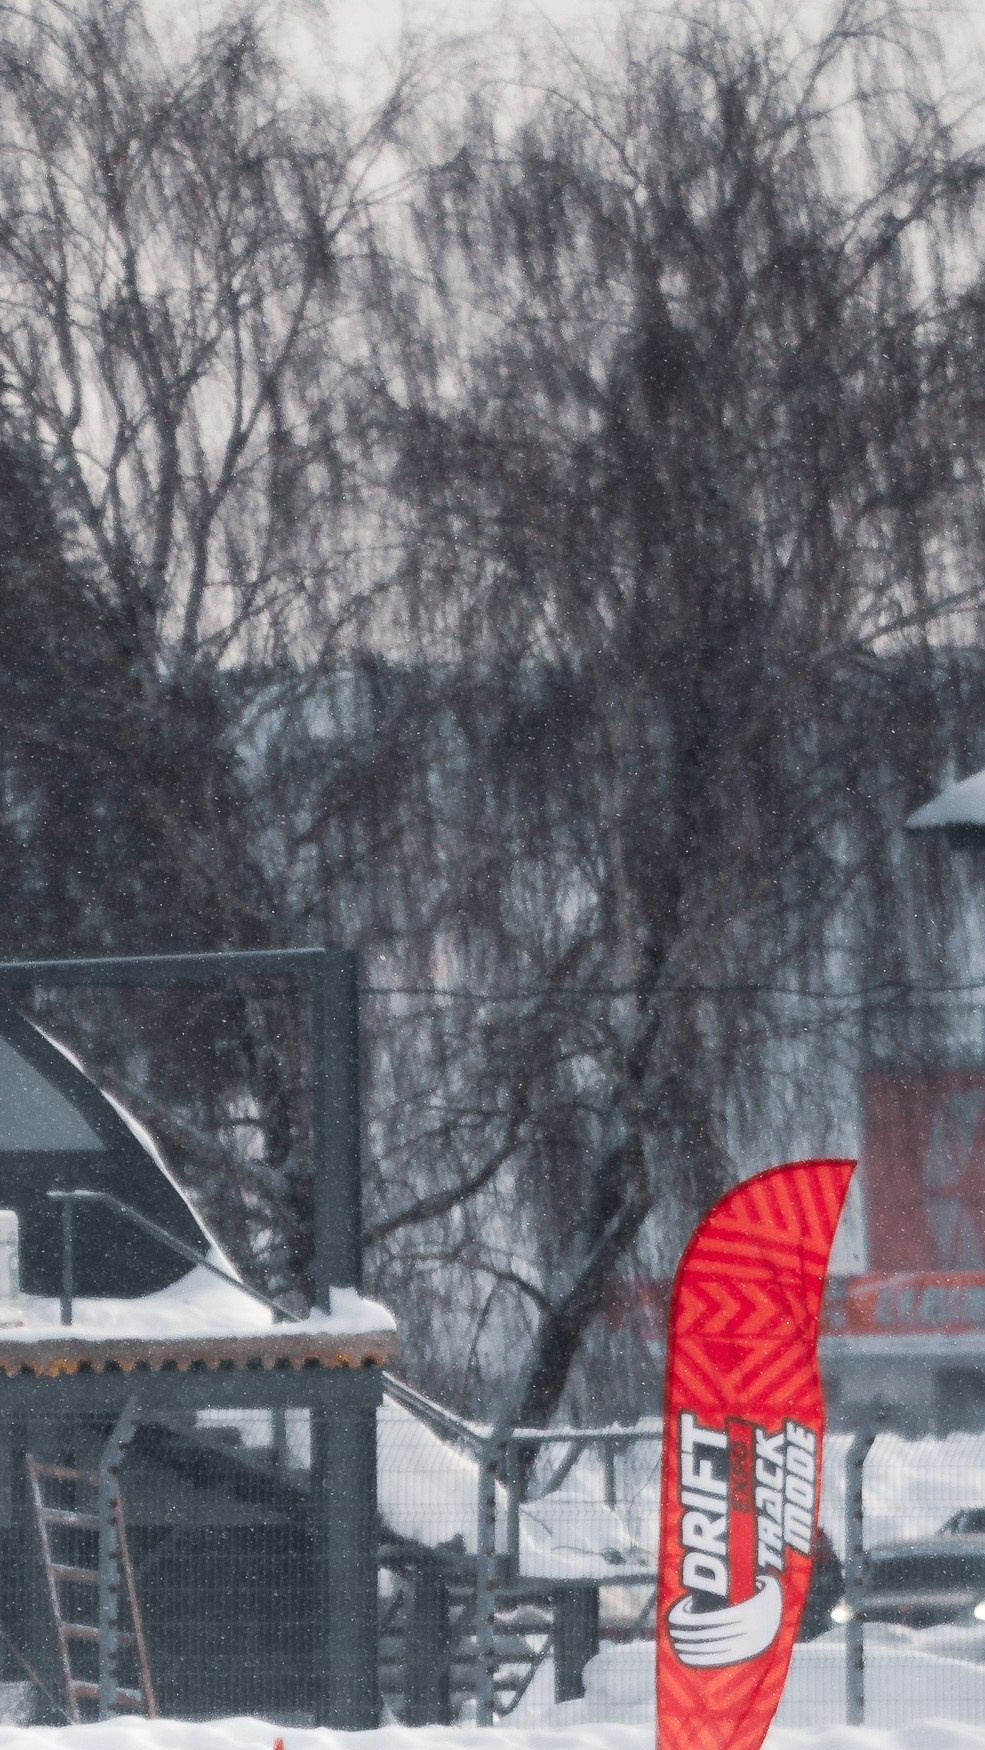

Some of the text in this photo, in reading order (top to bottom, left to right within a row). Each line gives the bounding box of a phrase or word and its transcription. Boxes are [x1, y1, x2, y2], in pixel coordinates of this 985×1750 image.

[681, 1411, 728, 1597] DRIFT
[755, 1428, 784, 1571] TRACK
[784, 1421, 815, 1554] MODE
